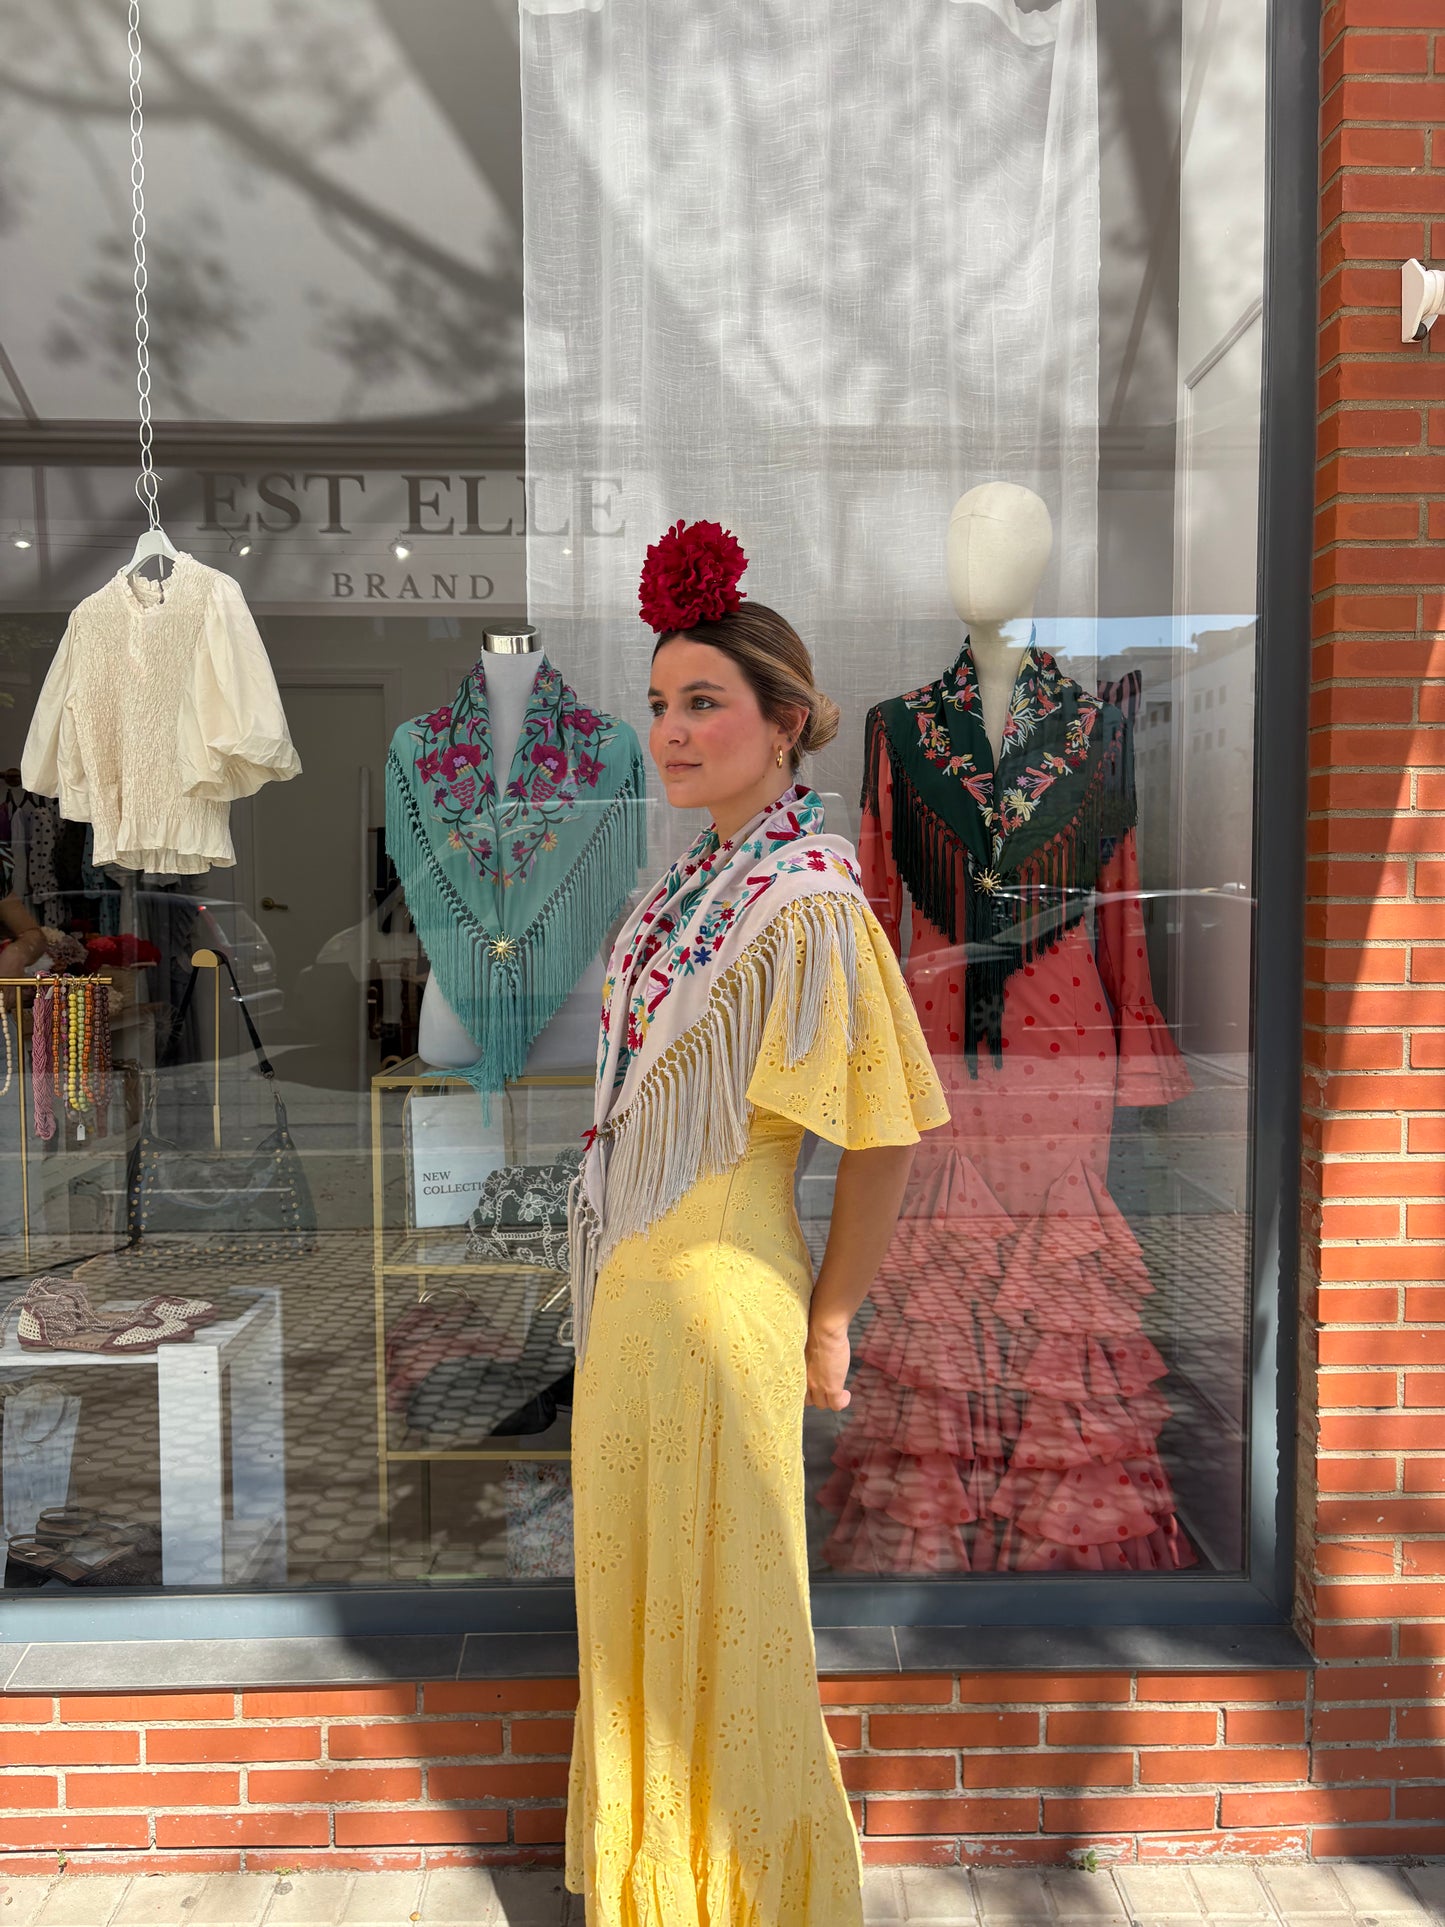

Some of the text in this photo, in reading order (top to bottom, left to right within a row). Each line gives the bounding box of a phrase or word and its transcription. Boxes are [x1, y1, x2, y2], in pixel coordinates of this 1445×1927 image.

[196, 471, 627, 537] EST ELLE
[331, 572, 494, 599] BRAND
[423, 1171, 451, 1182] NEW
